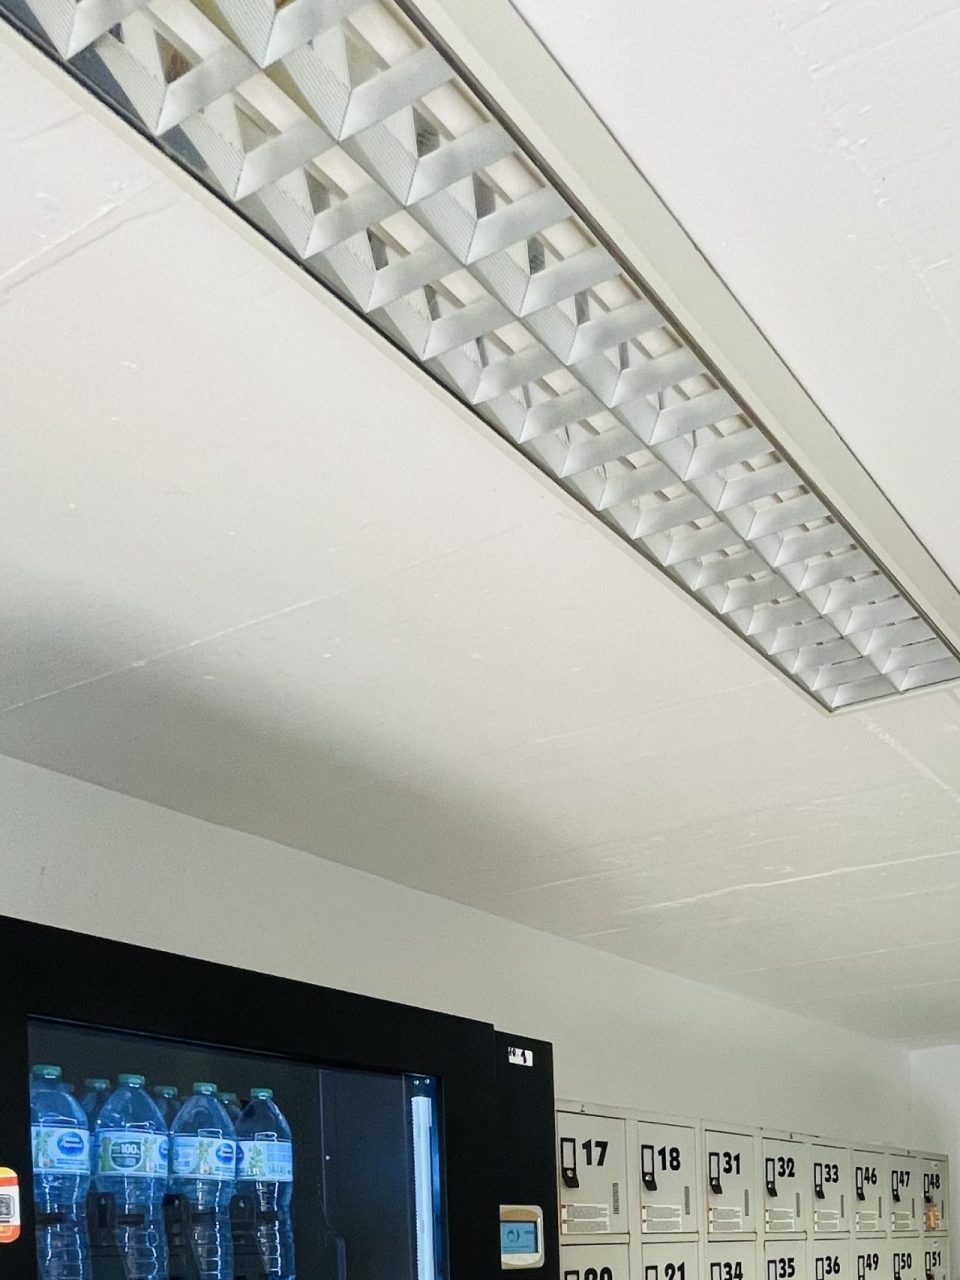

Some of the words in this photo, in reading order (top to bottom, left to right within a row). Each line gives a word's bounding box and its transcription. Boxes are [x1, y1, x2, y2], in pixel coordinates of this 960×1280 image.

[582, 1139, 608, 1166] 17
[658, 1146, 680, 1170] 18
[723, 1152, 740, 1174] 31
[778, 1157, 795, 1177] 32
[825, 1164, 838, 1183] 33
[864, 1167, 877, 1184] 46
[900, 1171, 910, 1187] 47
[930, 1174, 940, 1190] 48
[779, 1258, 795, 1278] 35
[826, 1256, 840, 1274] 36
[866, 1254, 879, 1270] 49
[901, 1253, 911, 1269] 50
[932, 1251, 940, 1267] 51
